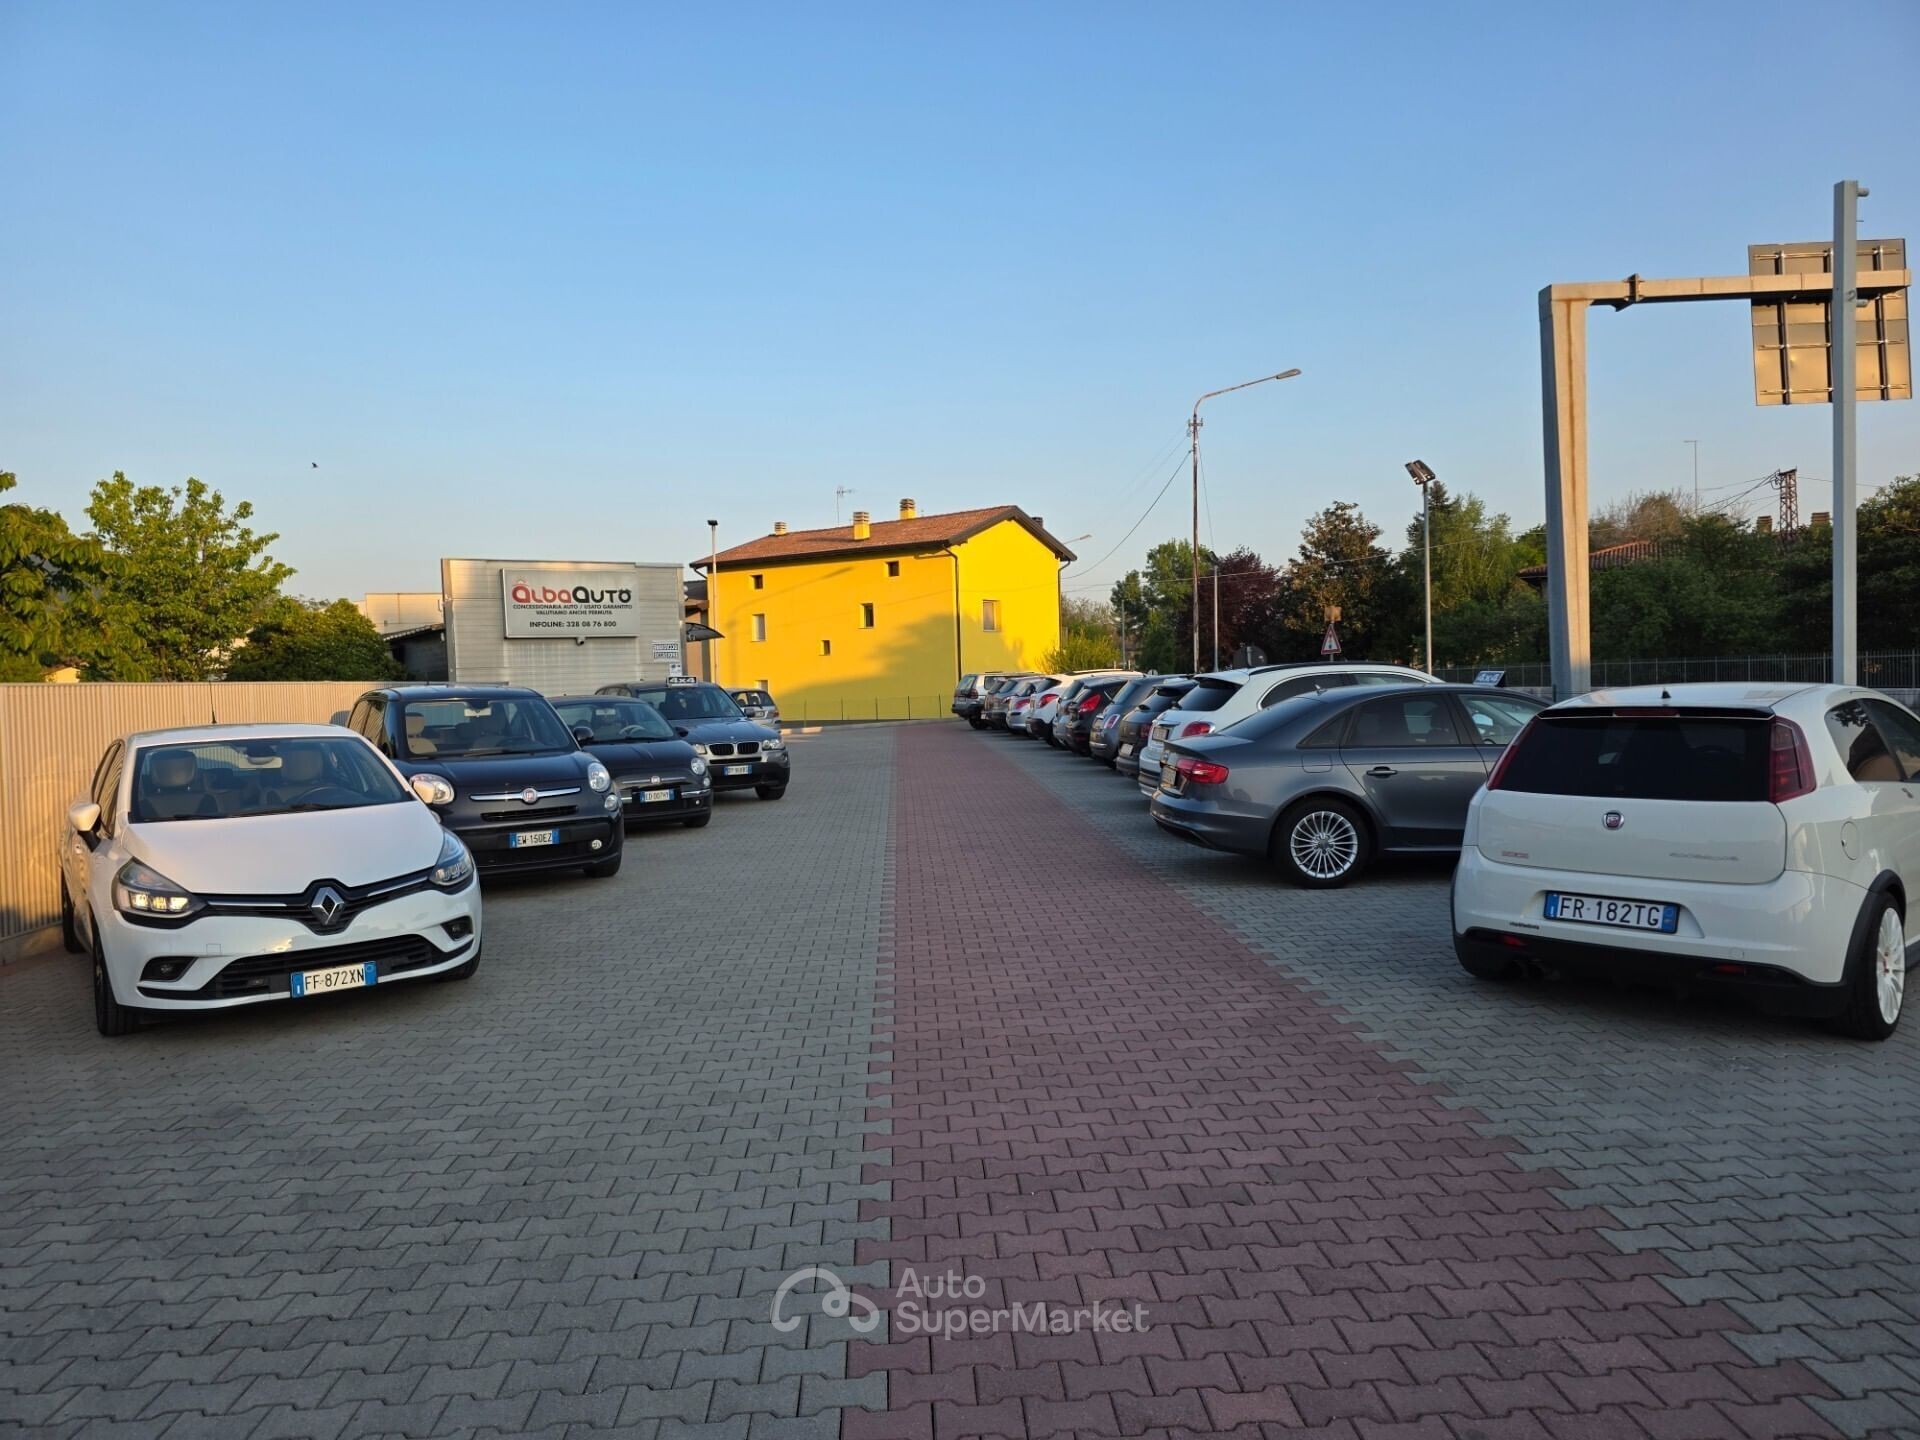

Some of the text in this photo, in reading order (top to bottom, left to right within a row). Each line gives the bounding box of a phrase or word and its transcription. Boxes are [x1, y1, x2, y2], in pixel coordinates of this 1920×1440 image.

[529, 620, 565, 628] INFOLINE:
[566, 620, 580, 628] 328
[592, 620, 602, 628] 76
